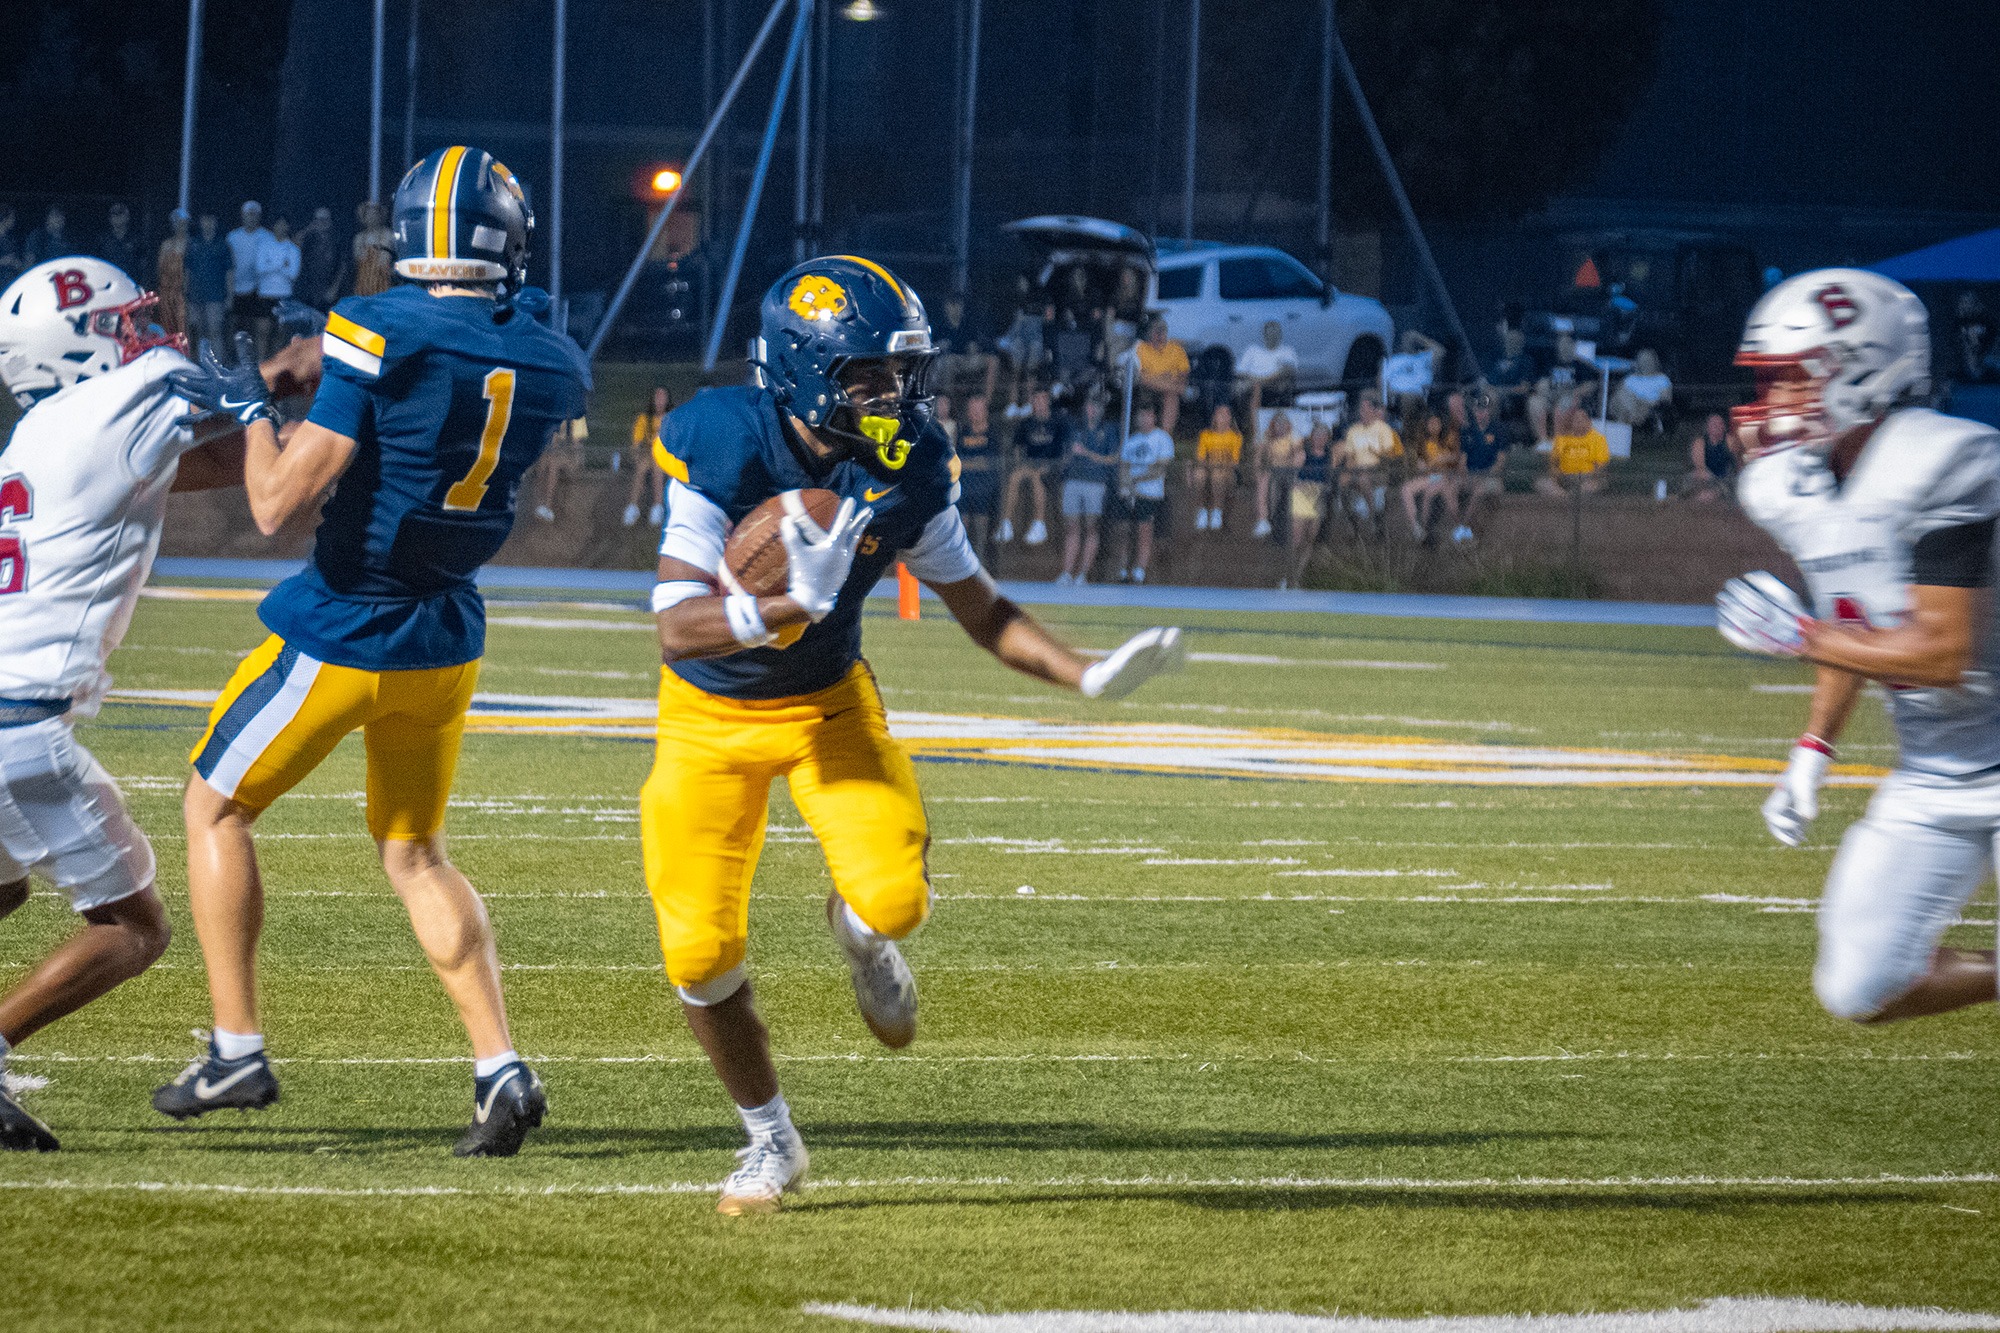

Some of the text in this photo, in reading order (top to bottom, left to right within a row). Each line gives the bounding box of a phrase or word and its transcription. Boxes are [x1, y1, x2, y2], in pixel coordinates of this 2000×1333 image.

[50, 269, 94, 312] B
[408, 263, 487, 279] BEAVERS
[443, 367, 516, 512] 1
